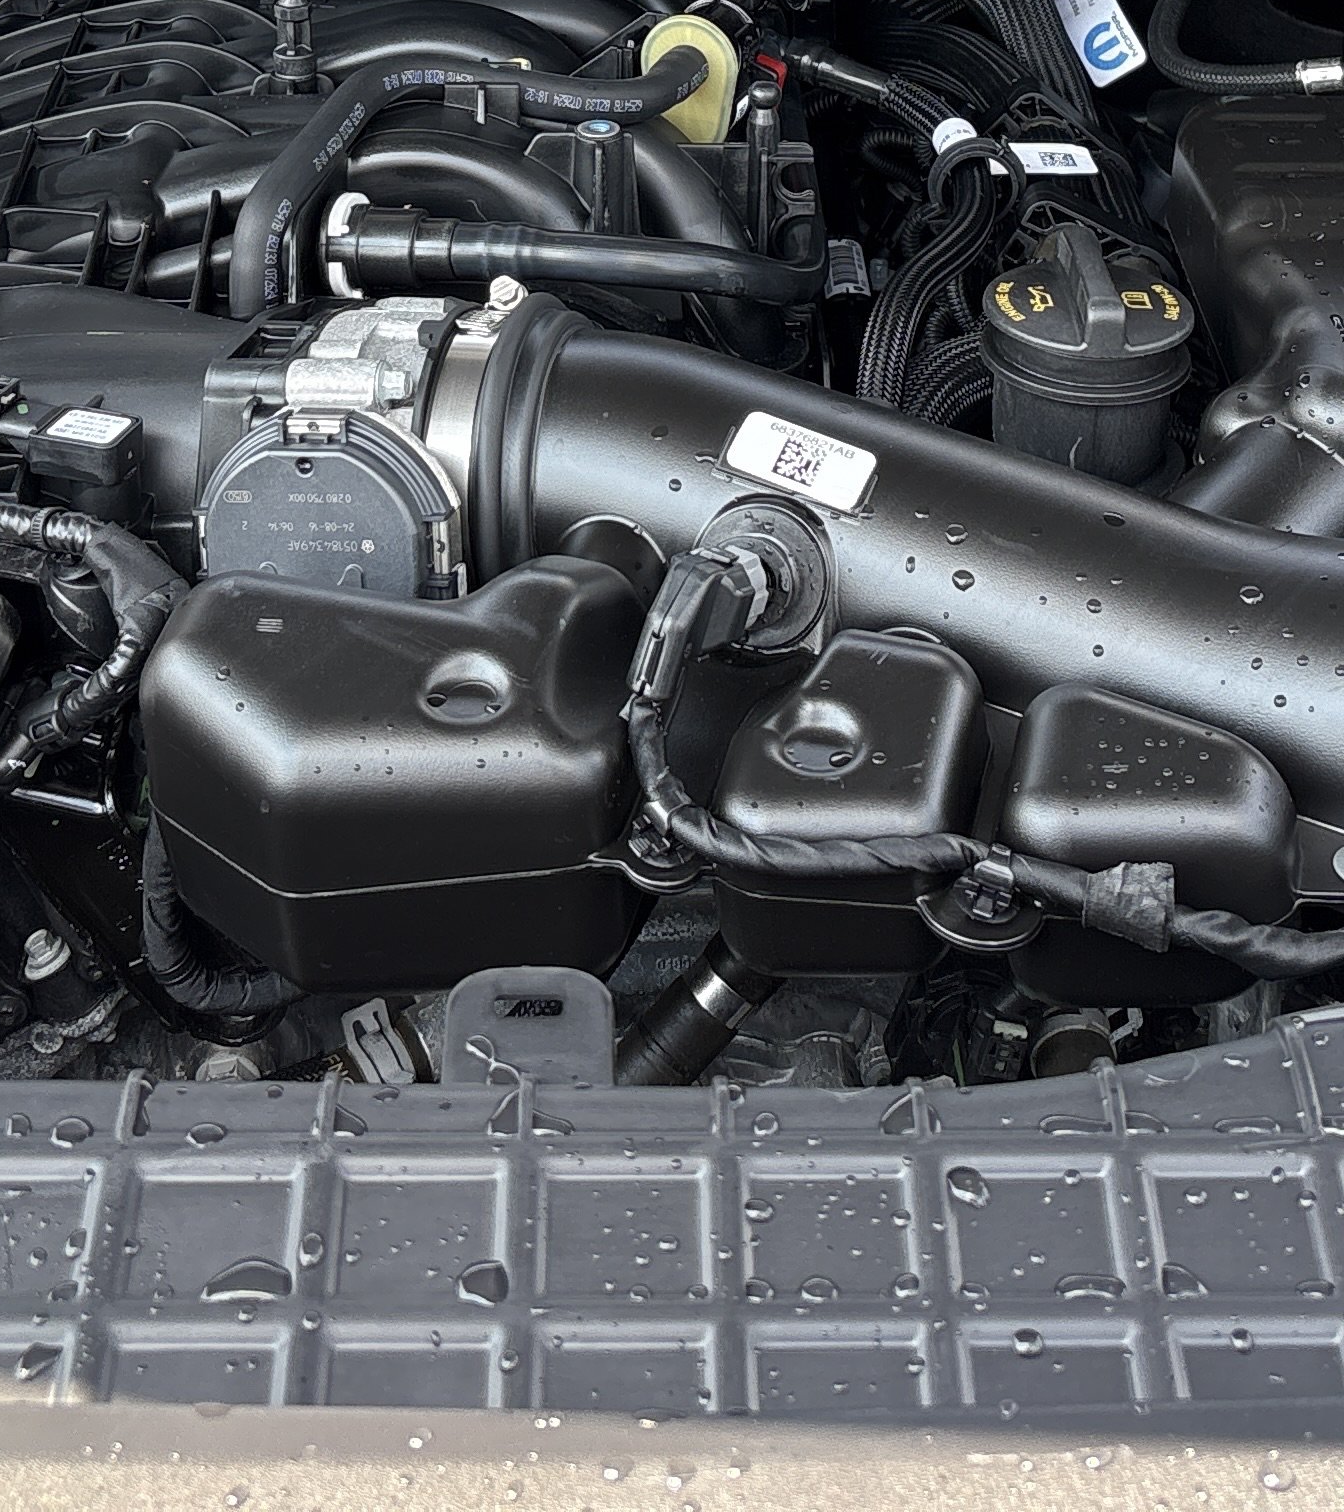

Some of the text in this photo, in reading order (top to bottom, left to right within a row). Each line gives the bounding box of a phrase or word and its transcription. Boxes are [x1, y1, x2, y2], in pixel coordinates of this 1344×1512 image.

[1111, 10, 1138, 57] MOPAR
[995, 293, 1027, 322] ENGINE
[1163, 305, 1180, 321] SAE
[769, 419, 856, 462] 68376821AB
[241, 519, 249, 531] 2
[287, 538, 358, 552] 05184349AF
